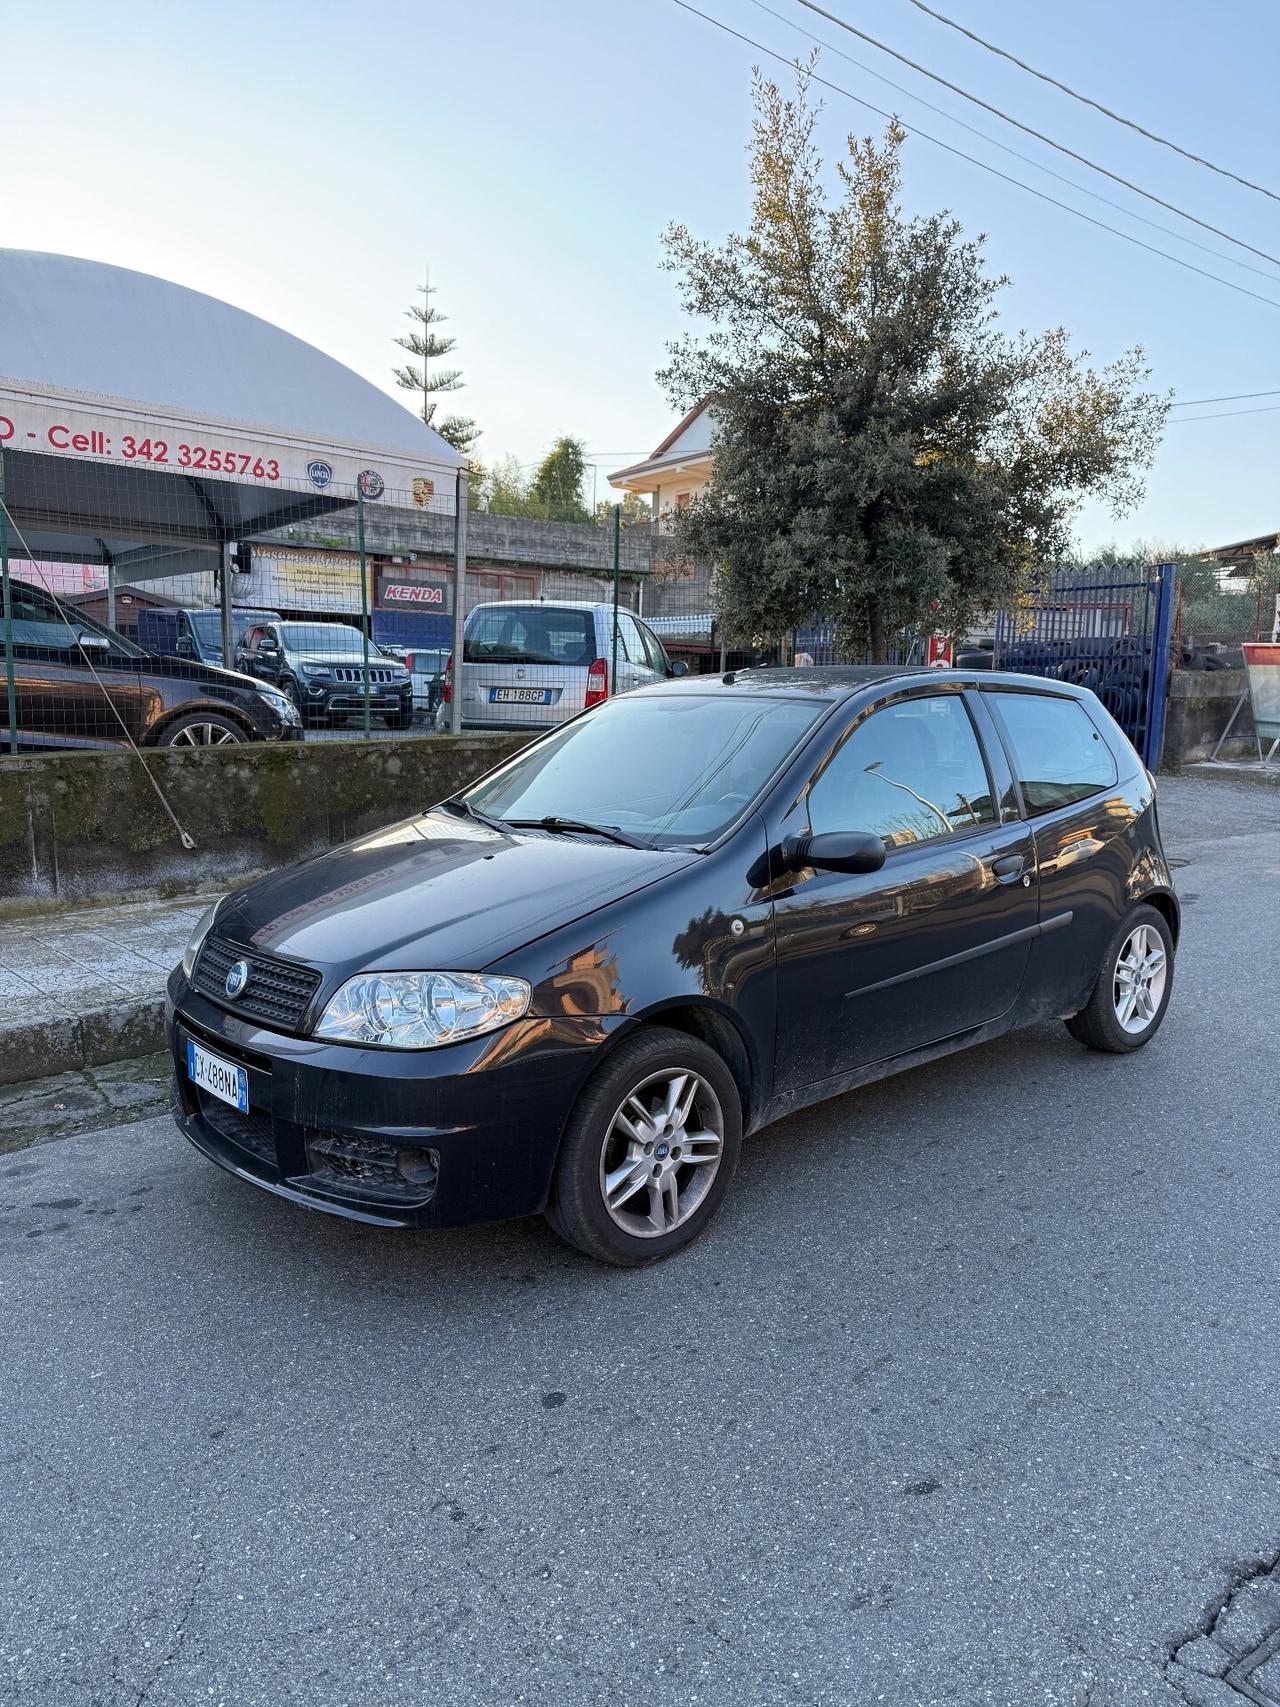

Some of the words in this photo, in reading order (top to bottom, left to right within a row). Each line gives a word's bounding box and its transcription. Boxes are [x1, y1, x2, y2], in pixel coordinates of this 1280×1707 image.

[47, 425, 112, 456] Cell:
[121, 435, 169, 463] 342
[177, 444, 280, 481] 3255763
[311, 469, 329, 480] LANCIA
[384, 585, 442, 603] KENDA
